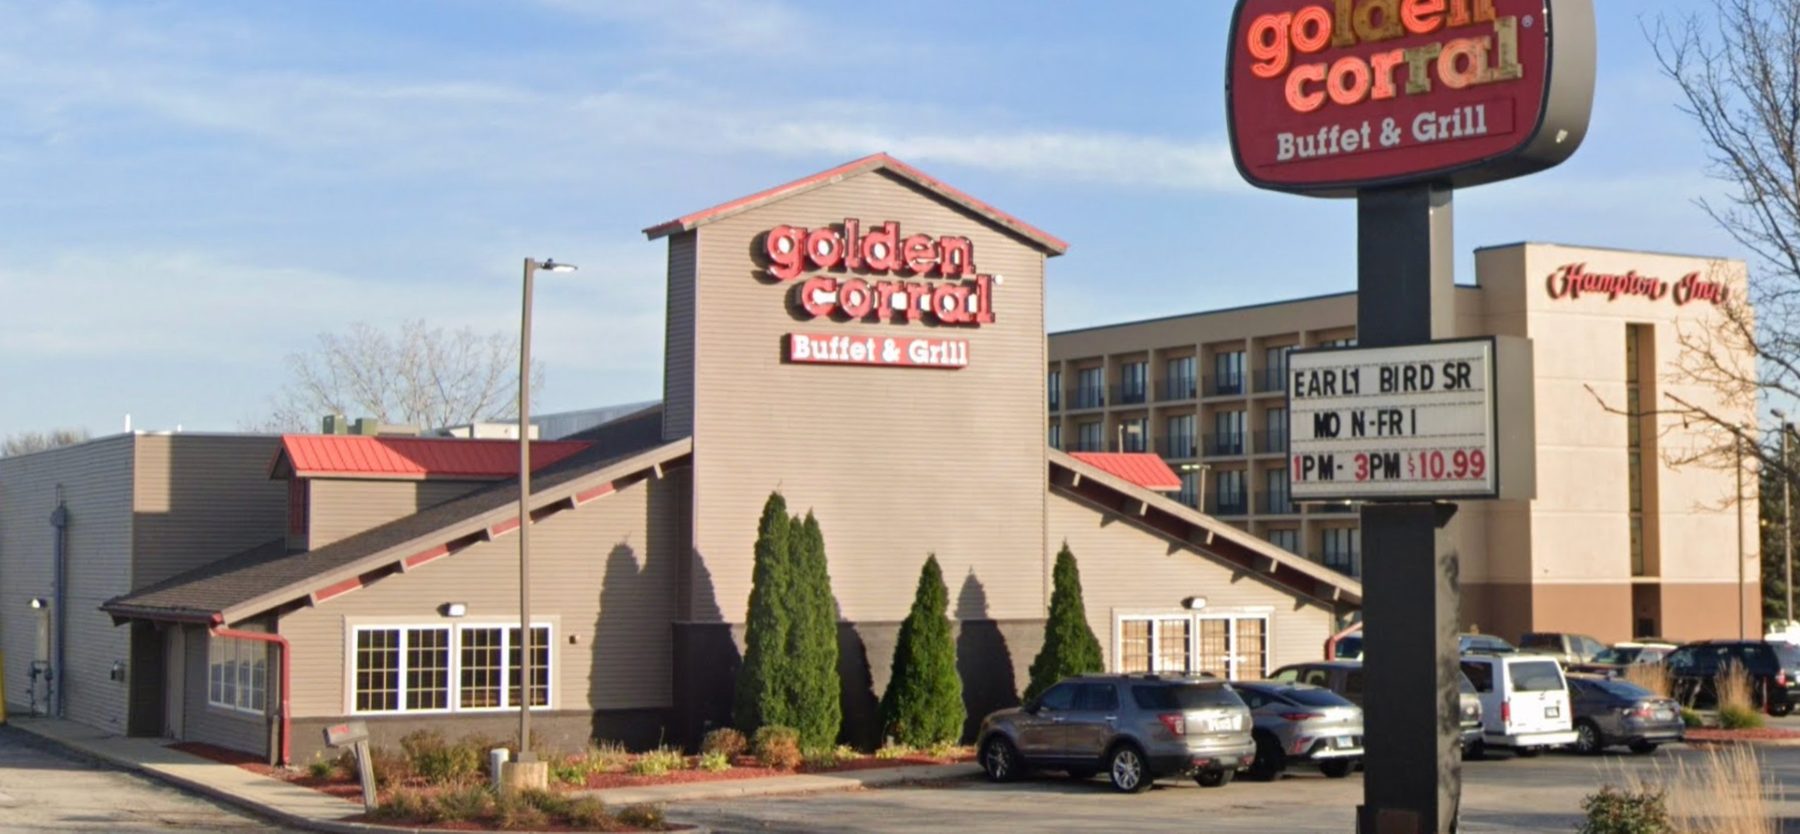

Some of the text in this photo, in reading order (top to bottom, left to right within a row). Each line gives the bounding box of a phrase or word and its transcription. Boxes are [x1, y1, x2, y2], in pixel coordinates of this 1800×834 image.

[1285, 16, 1523, 112] corral
[1277, 104, 1487, 161] Buffet & Grill
[767, 218, 976, 281] golden
[801, 274, 996, 324] corral
[1547, 262, 1729, 306] Hampton Inn
[792, 334, 968, 366] Buffet & Grill
[1380, 364, 1434, 393] BIRD
[1443, 362, 1472, 389] SR
[1354, 452, 1400, 481] 3PM
[1407, 450, 1486, 481] $10.99
